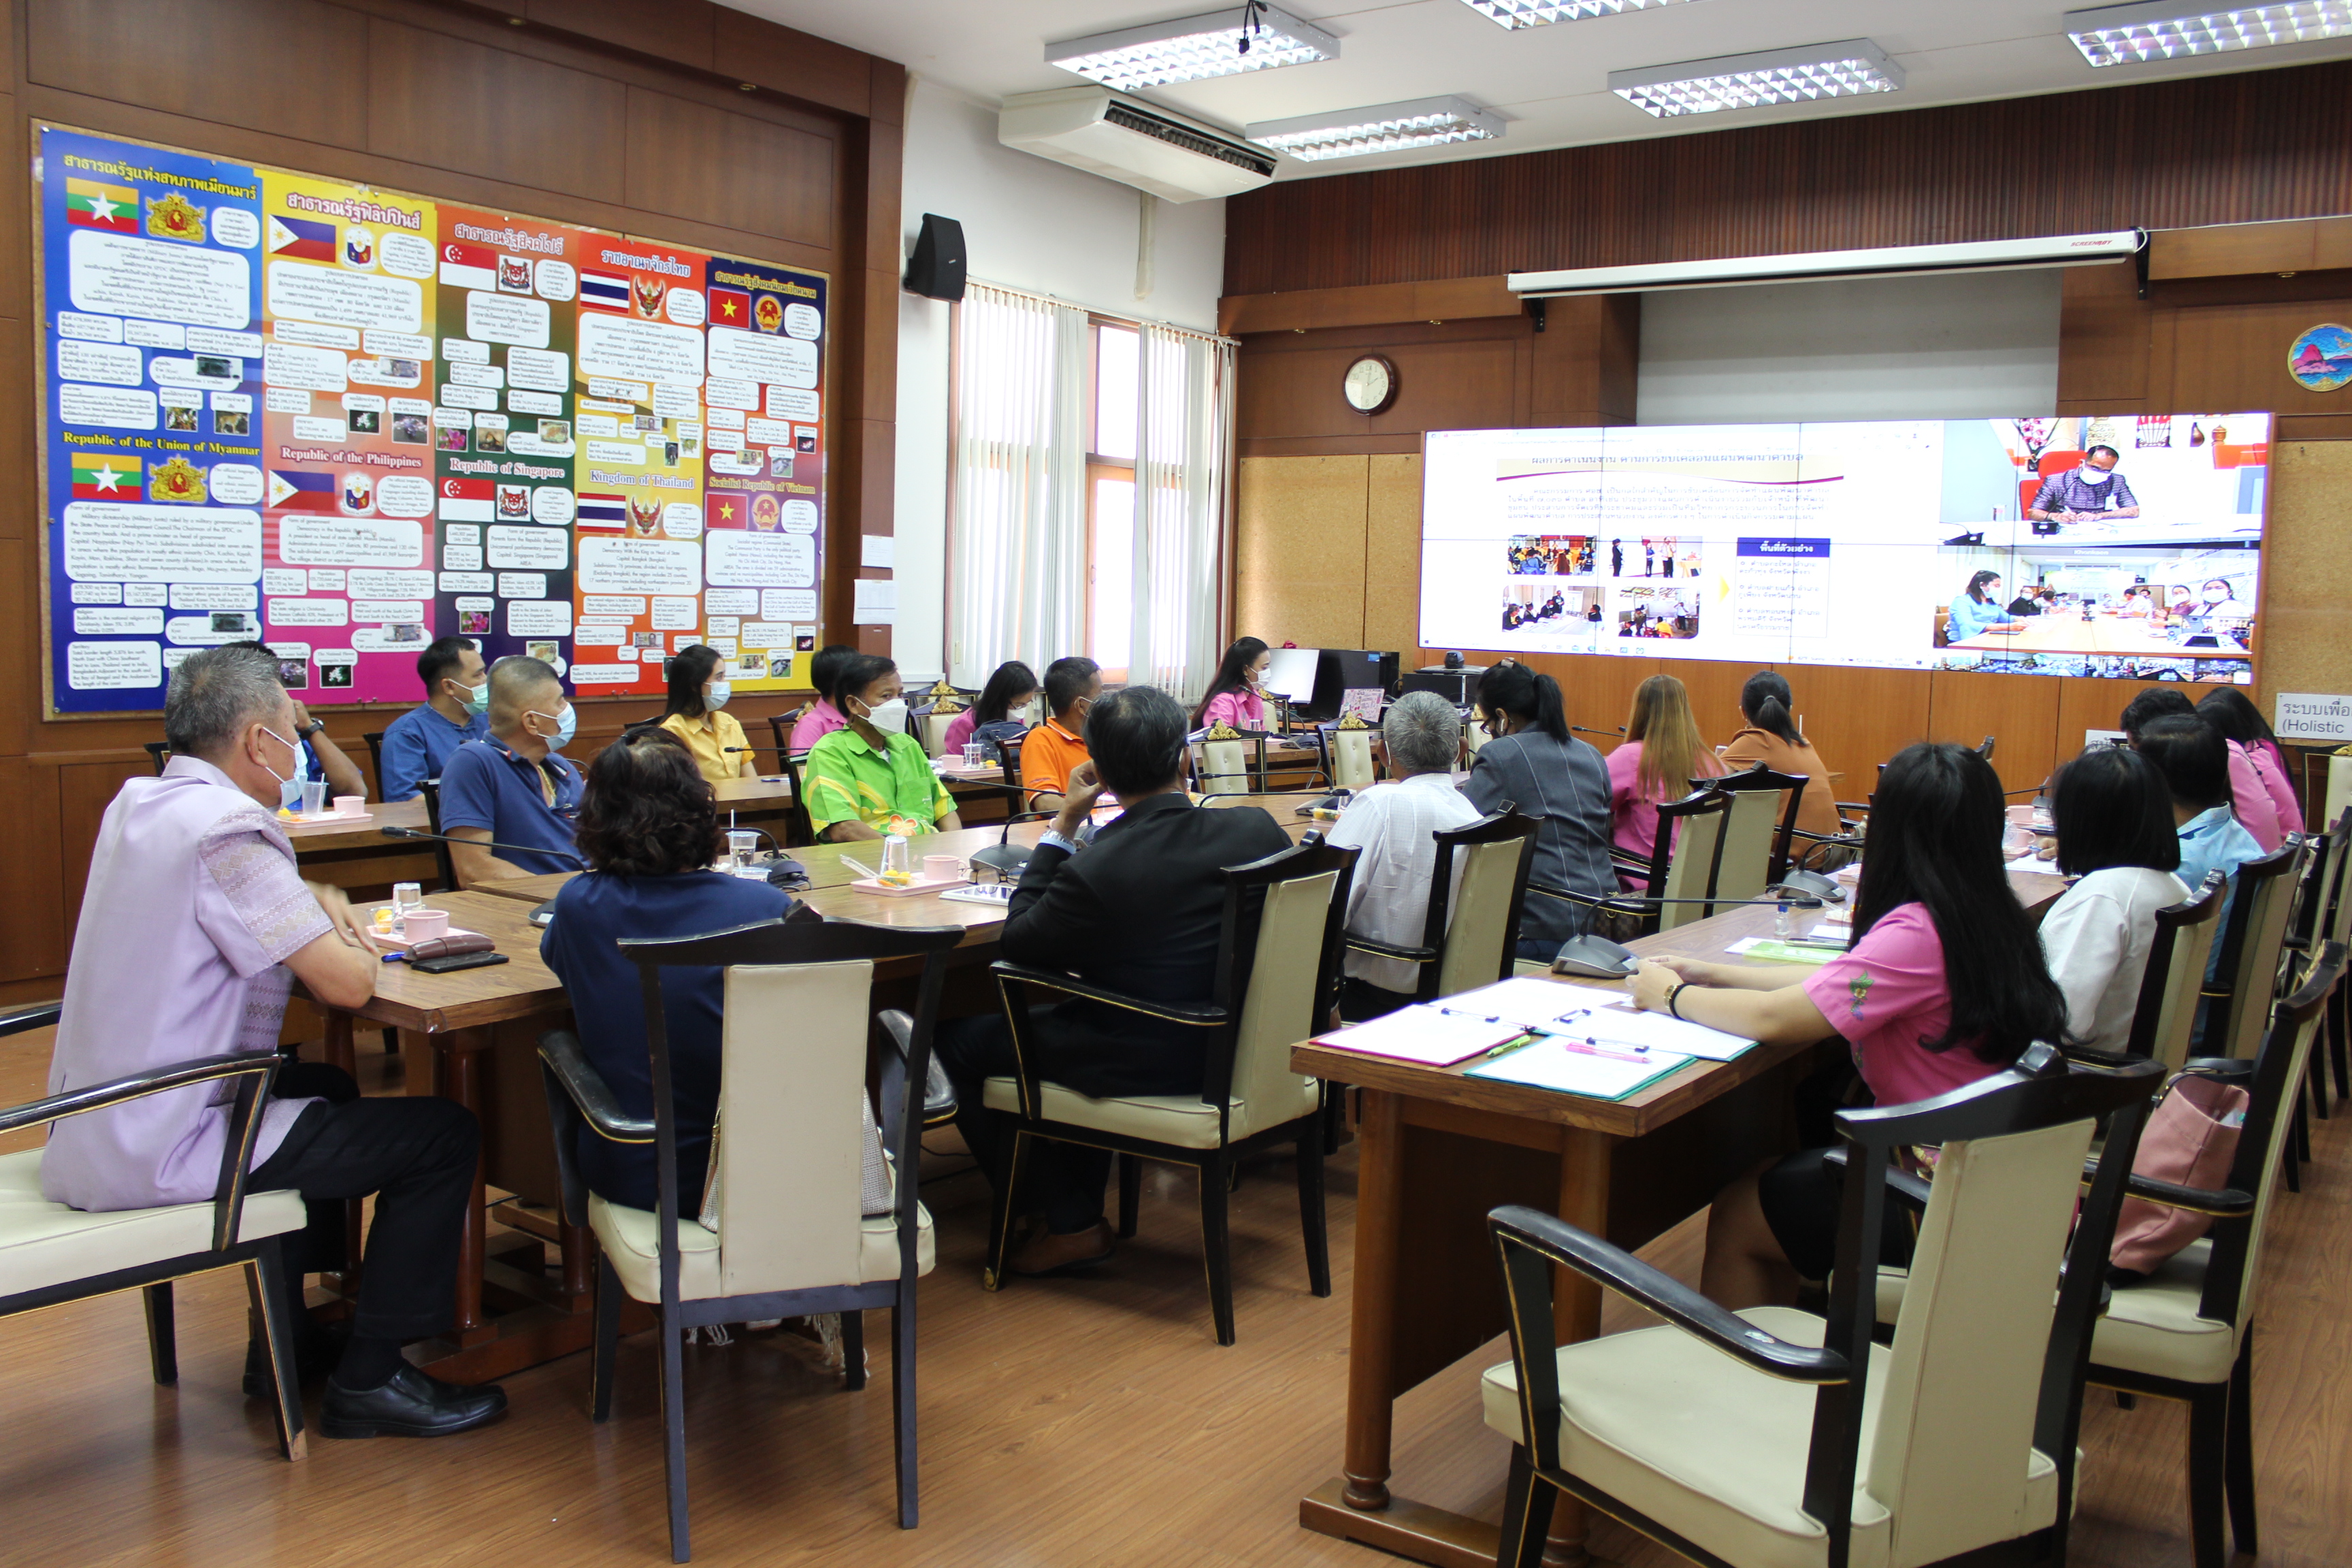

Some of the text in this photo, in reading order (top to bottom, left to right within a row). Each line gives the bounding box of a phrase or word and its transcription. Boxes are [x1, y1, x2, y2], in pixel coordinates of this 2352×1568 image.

[287, 192, 421, 230] สาธารณรัฐฟิลิปปินส์
[455, 223, 564, 255] สาธารณรัฐสิงคโปร์
[601, 249, 691, 278] ราชอาณาจักรไทย
[63, 431, 260, 456] Republic of the Union of Myanmar
[281, 446, 422, 468] Republic of the Philippines
[450, 457, 565, 479] Republic of Singapore
[589, 470, 695, 490] Kingdom of Thailand
[709, 476, 815, 494] Socialist Republic of Vietnam
[2283, 698, 2352, 717] ระบบเพื่อ
[2283, 719, 2345, 734] (Holistic
